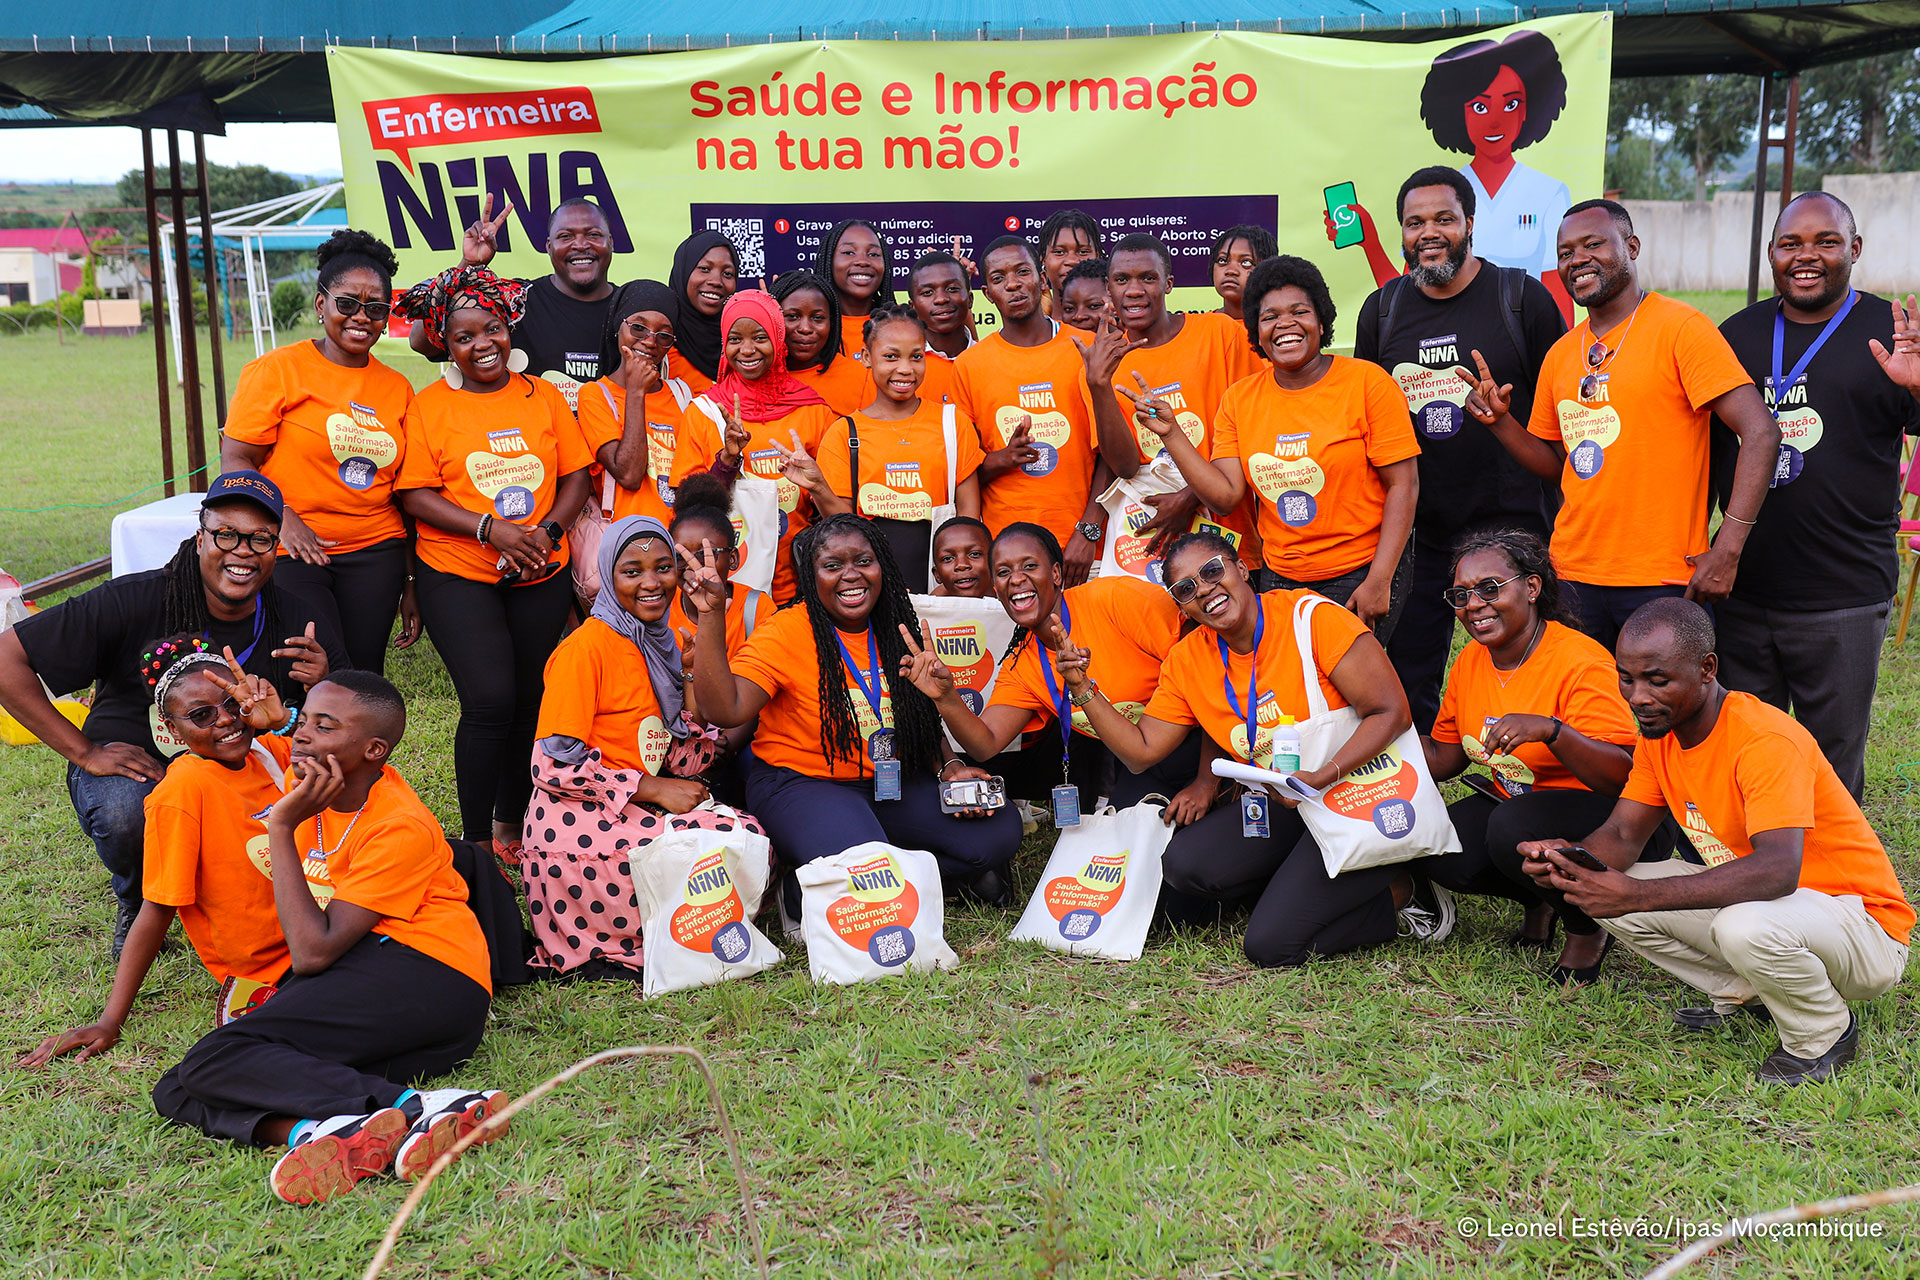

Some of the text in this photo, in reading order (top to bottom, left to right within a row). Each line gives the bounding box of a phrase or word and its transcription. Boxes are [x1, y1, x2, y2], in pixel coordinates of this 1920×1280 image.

[690, 61, 1257, 118] Saúde e Informação
[376, 97, 592, 138] Enfermeira
[697, 123, 1019, 170] na tua mão!
[778, 221, 785, 231] 1
[796, 220, 832, 230] Grava
[880, 218, 934, 229] número:
[1009, 219, 1016, 228] 2
[1101, 215, 1187, 228] que quiseres:
[898, 236, 914, 244] ou
[1160, 230, 1206, 240] Aborto
[894, 249, 910, 259] 85
[1400, 371, 1432, 383] Saúde
[1419, 391, 1435, 399] tua
[1438, 385, 1464, 396] mão!
[1037, 429, 1060, 438] mão!
[475, 459, 505, 471] Saúde
[485, 461, 540, 478] Informação
[1255, 462, 1284, 473] Saúde
[1266, 466, 1317, 481] Informação
[222, 477, 252, 488] Ipas
[478, 471, 535, 489] na tua mão!
[1274, 480, 1288, 489] tua
[1290, 476, 1314, 486] mão!
[778, 494, 792, 503] ão!
[867, 493, 898, 502] Saúde
[877, 499, 932, 511] Informação
[902, 510, 926, 518] mão!
[156, 735, 170, 744] na
[1333, 785, 1364, 800] Saúde
[1346, 779, 1400, 802] Informação
[1341, 788, 1398, 813] na tua mão!
[1055, 882, 1082, 891] Saúde
[1060, 891, 1109, 901] Informação
[836, 902, 865, 916] Saúde
[1078, 900, 1100, 908] mão!
[675, 907, 702, 925] Saúde
[685, 900, 735, 930] Informação
[846, 902, 902, 923] Informação
[681, 910, 733, 943] na tua mão!
[854, 921, 871, 931] tua
[873, 912, 898, 926] mão!
